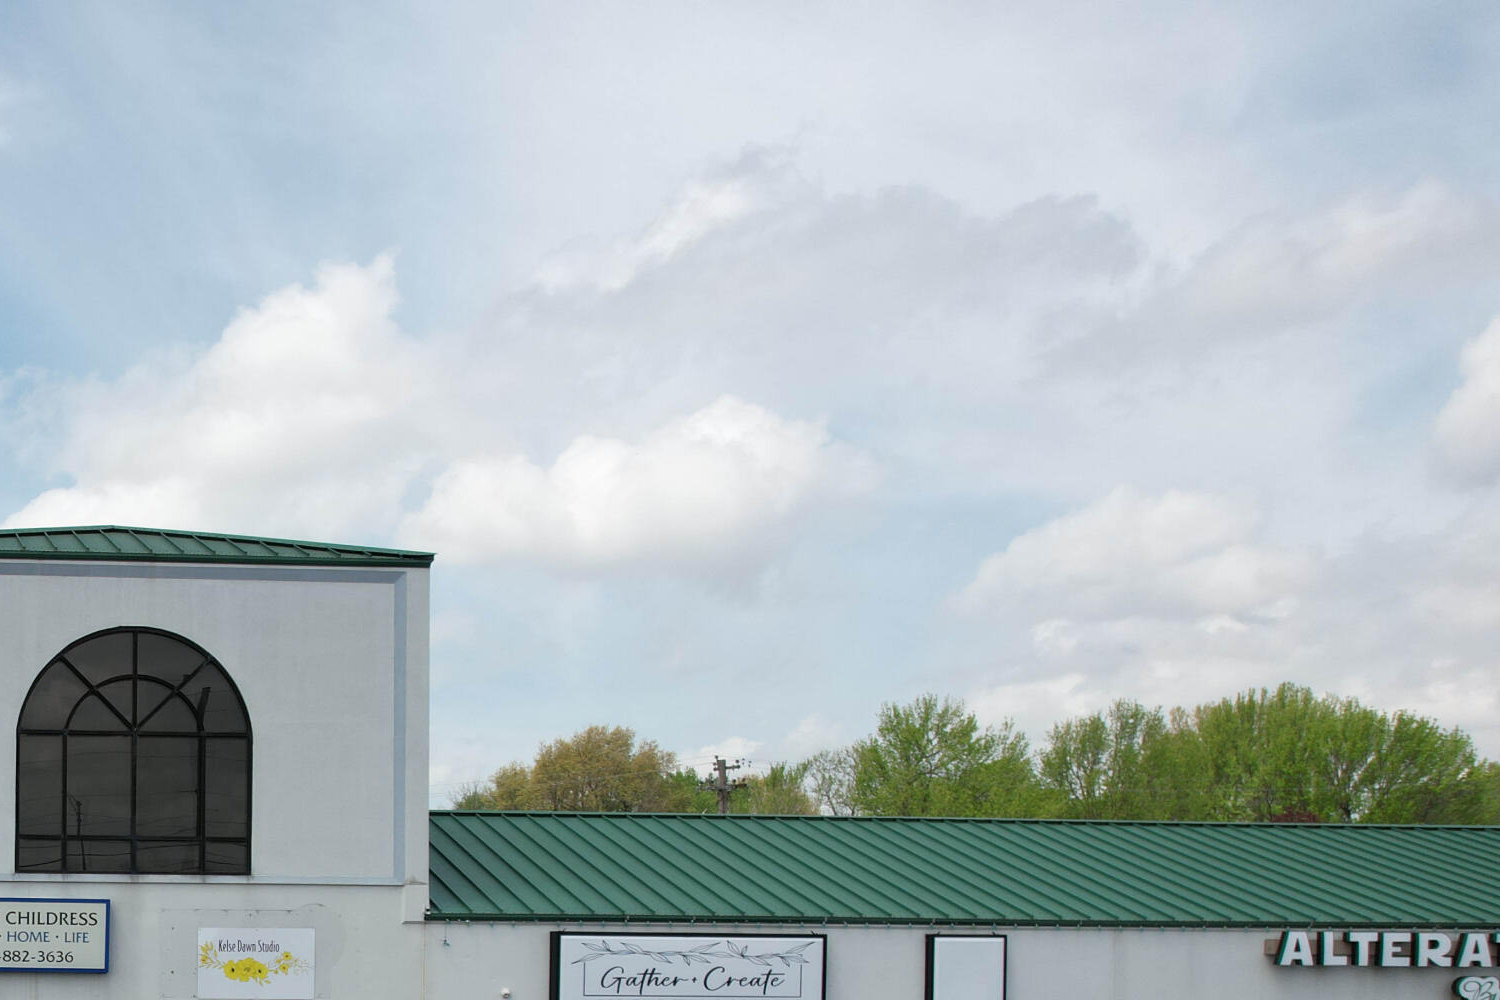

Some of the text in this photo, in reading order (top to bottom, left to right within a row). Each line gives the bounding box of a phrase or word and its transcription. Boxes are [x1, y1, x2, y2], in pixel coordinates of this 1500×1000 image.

[5, 911, 98, 926] CHILDRESS
[6, 931, 51, 943] HOME
[64, 932, 89, 943] LIFE
[218, 939, 280, 953] Kelse Dawn Studio
[1278, 931, 1500, 967] ALTERA
[600, 965, 688, 995] Gather
[703, 965, 786, 995] Create
